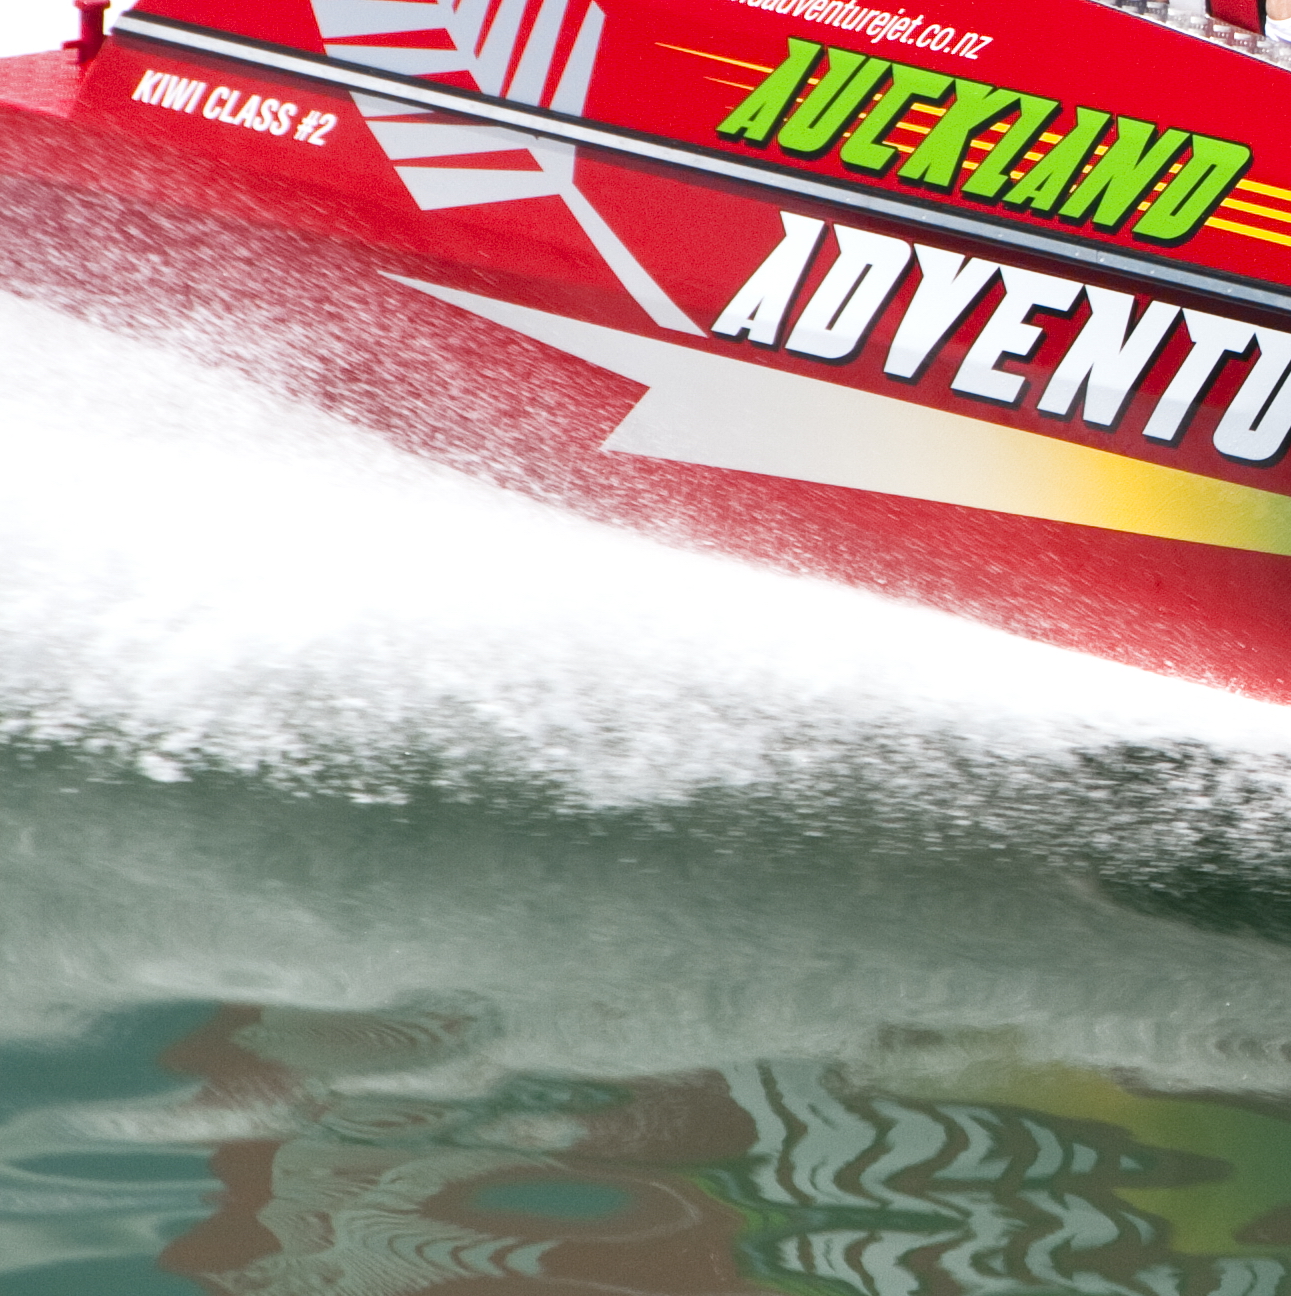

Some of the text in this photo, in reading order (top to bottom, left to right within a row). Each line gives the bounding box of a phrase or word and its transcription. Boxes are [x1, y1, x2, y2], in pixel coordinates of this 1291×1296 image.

[132, 70, 338, 147] KIWI CLASS #2
[714, 36, 1254, 246] AUCKLAND
